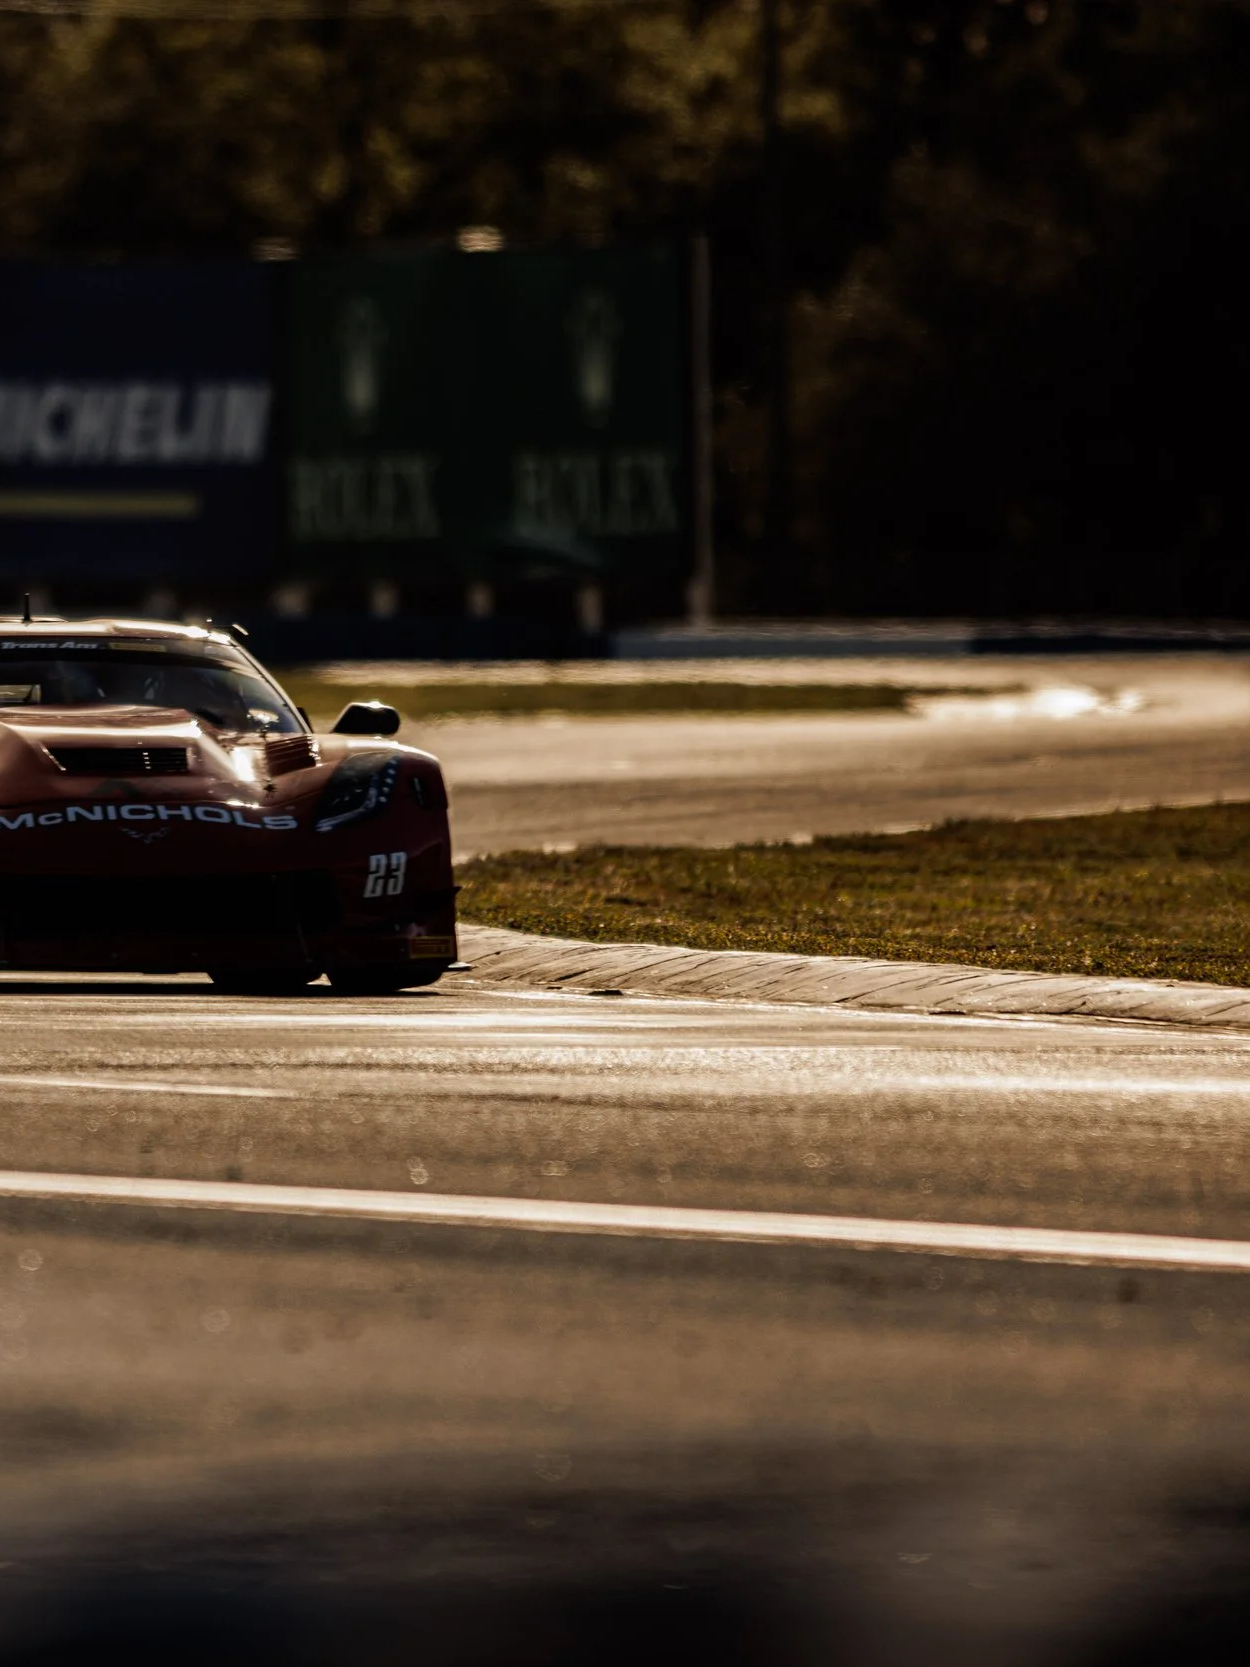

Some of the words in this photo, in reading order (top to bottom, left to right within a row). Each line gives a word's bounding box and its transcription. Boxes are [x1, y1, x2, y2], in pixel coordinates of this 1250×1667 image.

[290, 452, 442, 540] ROLEX
[512, 448, 678, 536] ROLEX
[0, 641, 59, 650] Trans
[60, 641, 99, 650] Am
[362, 851, 408, 899] 23
